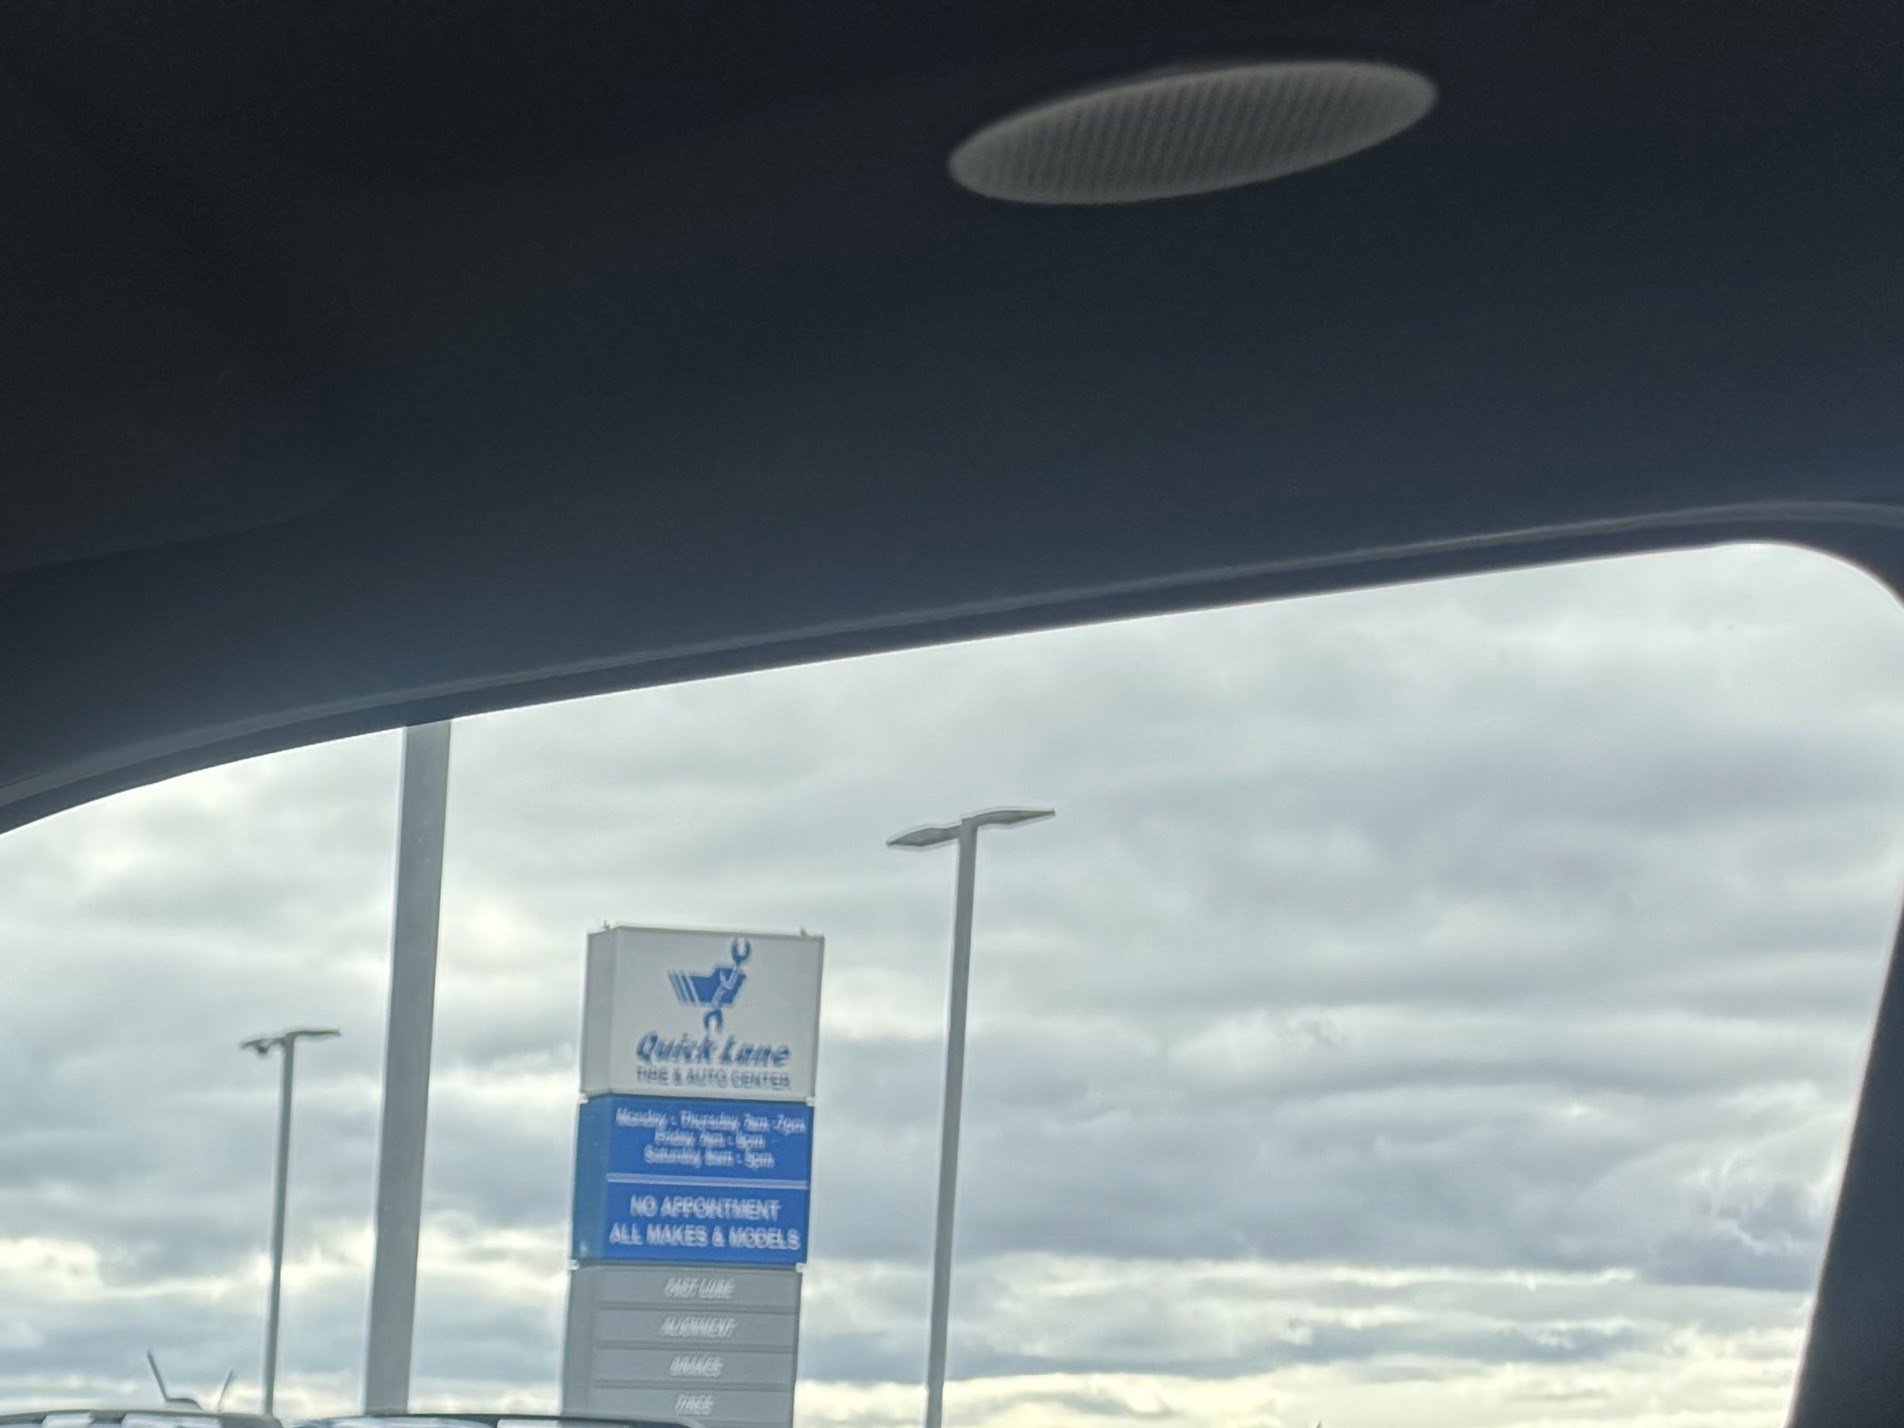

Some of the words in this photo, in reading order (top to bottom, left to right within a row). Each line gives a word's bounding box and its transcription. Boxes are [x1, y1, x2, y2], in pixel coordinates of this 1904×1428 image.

[636, 1031, 714, 1063] Quick
[720, 1035, 790, 1067] Lane
[686, 1068, 727, 1087] AUTO
[730, 1070, 790, 1088] CENTER
[630, 1194, 658, 1217] NO
[660, 1196, 781, 1221] APPOINTMENT
[610, 1223, 643, 1245] ALL
[647, 1224, 708, 1247] MAKES
[712, 1226, 726, 1247] &
[729, 1226, 801, 1251] MODELS
